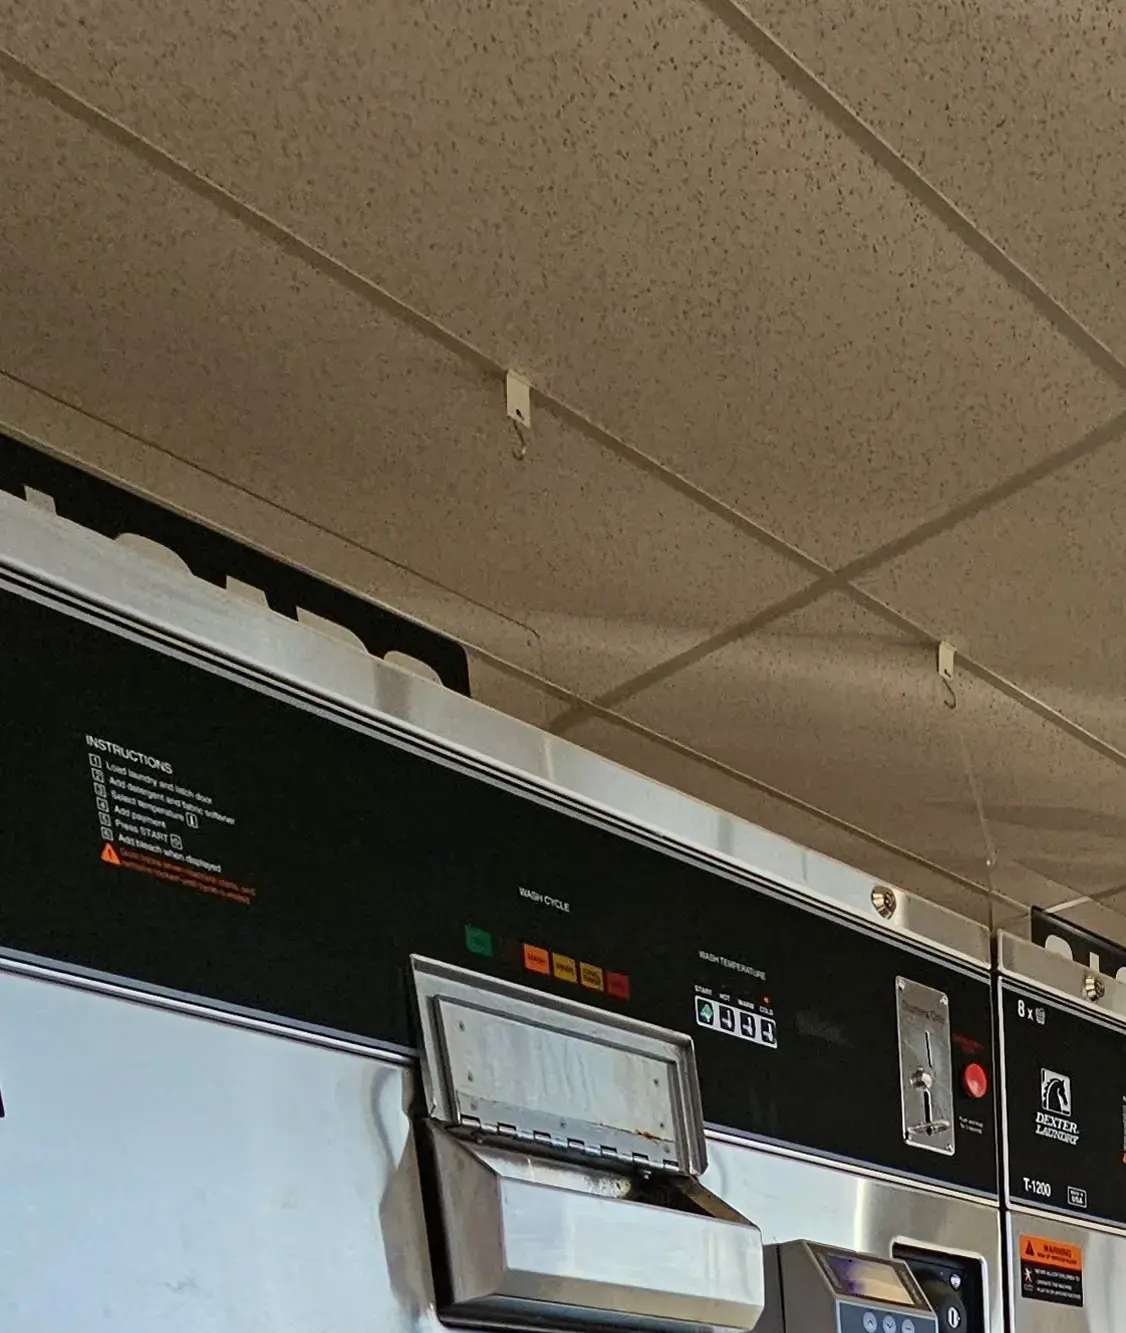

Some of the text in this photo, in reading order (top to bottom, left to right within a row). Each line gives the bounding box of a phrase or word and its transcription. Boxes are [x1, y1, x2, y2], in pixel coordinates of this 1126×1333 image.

[86, 734, 173, 774] INSTRUCTIONS
[140, 826, 168, 842] START
[519, 886, 570, 913] WASH CYCLE
[1018, 1000, 1025, 1018] 8
[1036, 1111, 1078, 1134] DEXTER
[1035, 1124, 1079, 1145] LAUNDRY
[1023, 1177, 1051, 1198] T-1200
